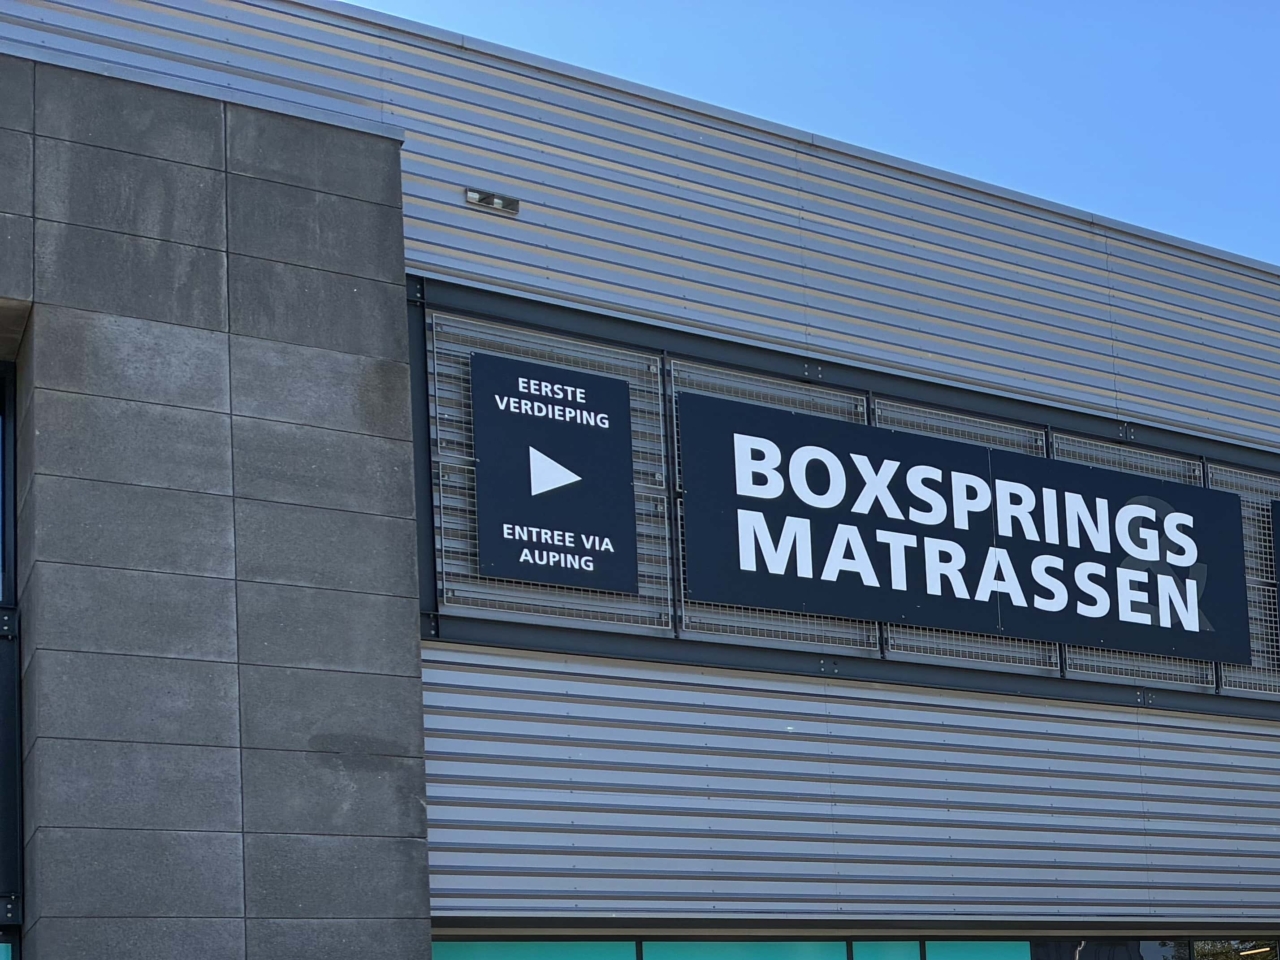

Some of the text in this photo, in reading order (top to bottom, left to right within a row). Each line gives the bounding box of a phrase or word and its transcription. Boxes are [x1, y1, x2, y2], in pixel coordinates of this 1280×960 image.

[518, 377, 586, 403] EERSTE
[494, 394, 609, 428] VERDIEPING
[733, 432, 1198, 567] BOXSPRINGS
[503, 523, 614, 552] ENTREE VIA
[519, 548, 594, 571] AUPING
[737, 508, 1200, 632] MATRASSEN
